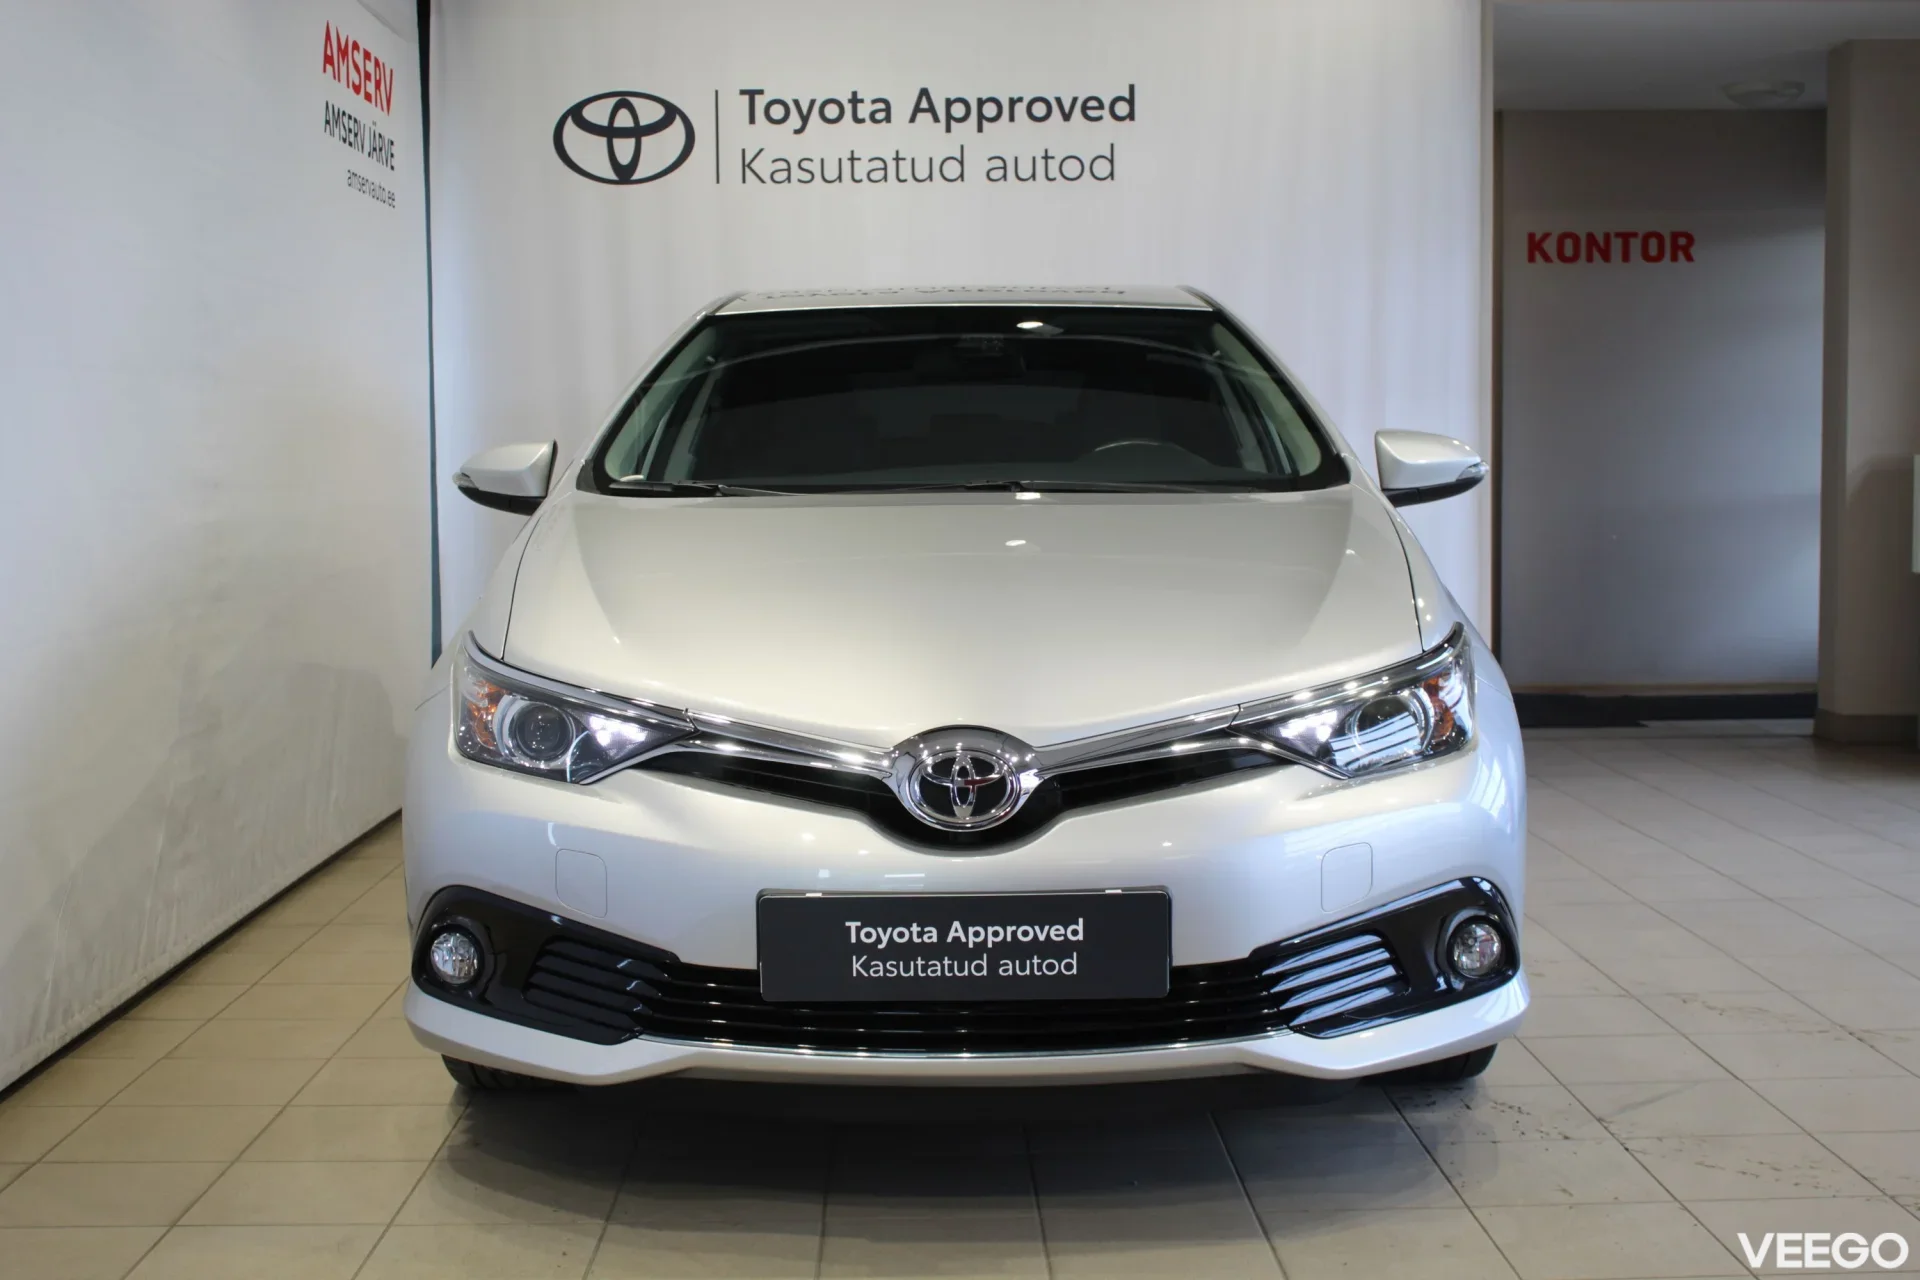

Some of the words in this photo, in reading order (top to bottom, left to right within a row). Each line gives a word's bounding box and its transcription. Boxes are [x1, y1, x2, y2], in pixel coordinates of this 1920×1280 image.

[323, 20, 394, 117] AMSERV
[739, 88, 892, 134] Toyota
[908, 83, 1136, 134] Approved
[324, 100, 366, 154] AMSERV
[368, 120, 395, 171] JÄRVE
[741, 144, 965, 184] Kasutatud
[985, 142, 1115, 182] autod
[347, 168, 396, 209] amservauto.ee
[1527, 231, 1695, 264] KONTOR
[845, 921, 938, 949] Toyota
[946, 917, 1084, 948] Approved
[852, 953, 988, 977] Kasutatud
[998, 952, 1078, 976] autod
